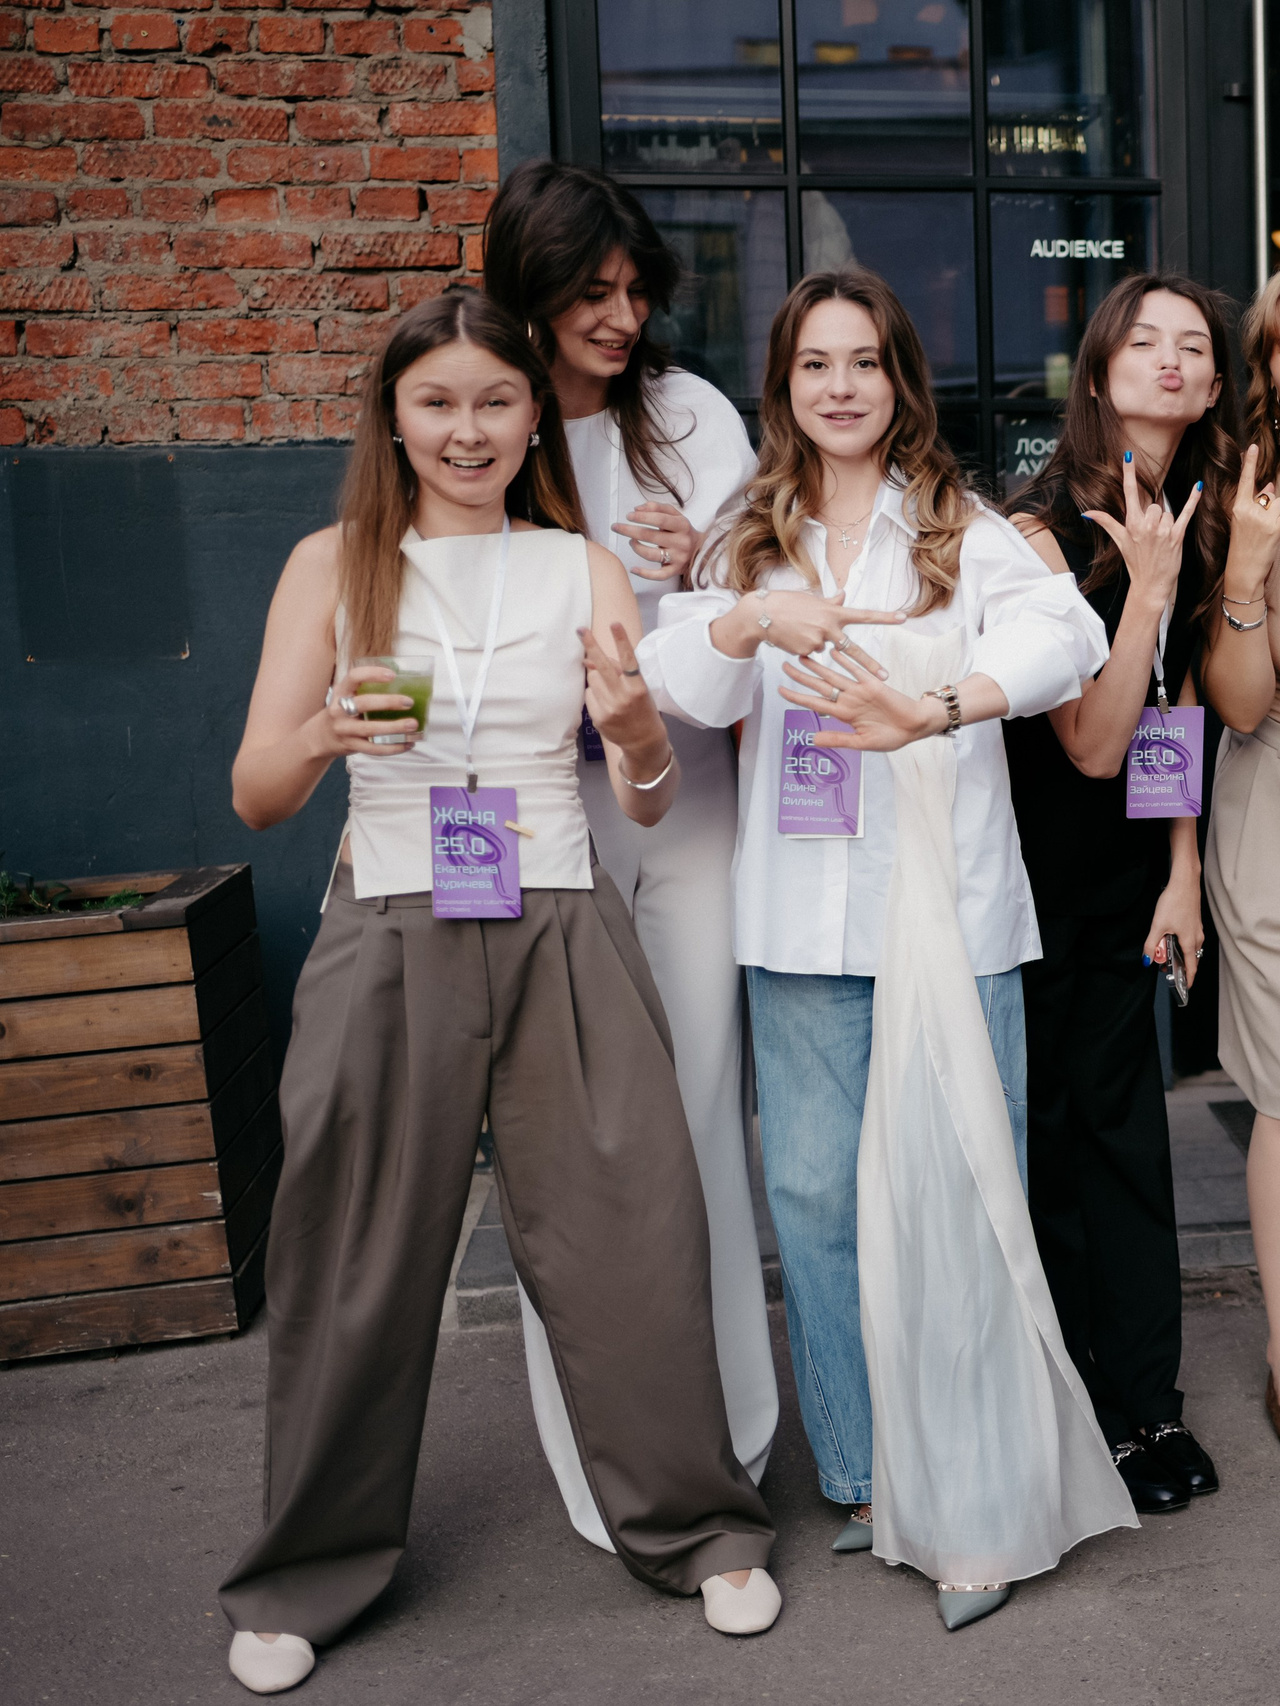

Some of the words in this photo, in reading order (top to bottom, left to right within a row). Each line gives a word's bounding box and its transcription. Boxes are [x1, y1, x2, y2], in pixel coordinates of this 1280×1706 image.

[1030, 239, 1125, 258] AUDIENCE
[1015, 438, 1058, 455] ЛОФ
[786, 729, 816, 746] Же
[1132, 724, 1185, 740] Женя
[785, 757, 831, 775] 25.0
[1131, 750, 1175, 766] 25.0
[1130, 773, 1184, 783] Екатерина
[783, 782, 816, 793] Арина
[1130, 785, 1173, 794] Зайцева
[782, 796, 824, 807] Филина
[433, 806, 495, 825] Женя
[435, 837, 485, 855] 25.0
[435, 864, 498, 876] Екатерина
[435, 879, 493, 890] Чуричева
